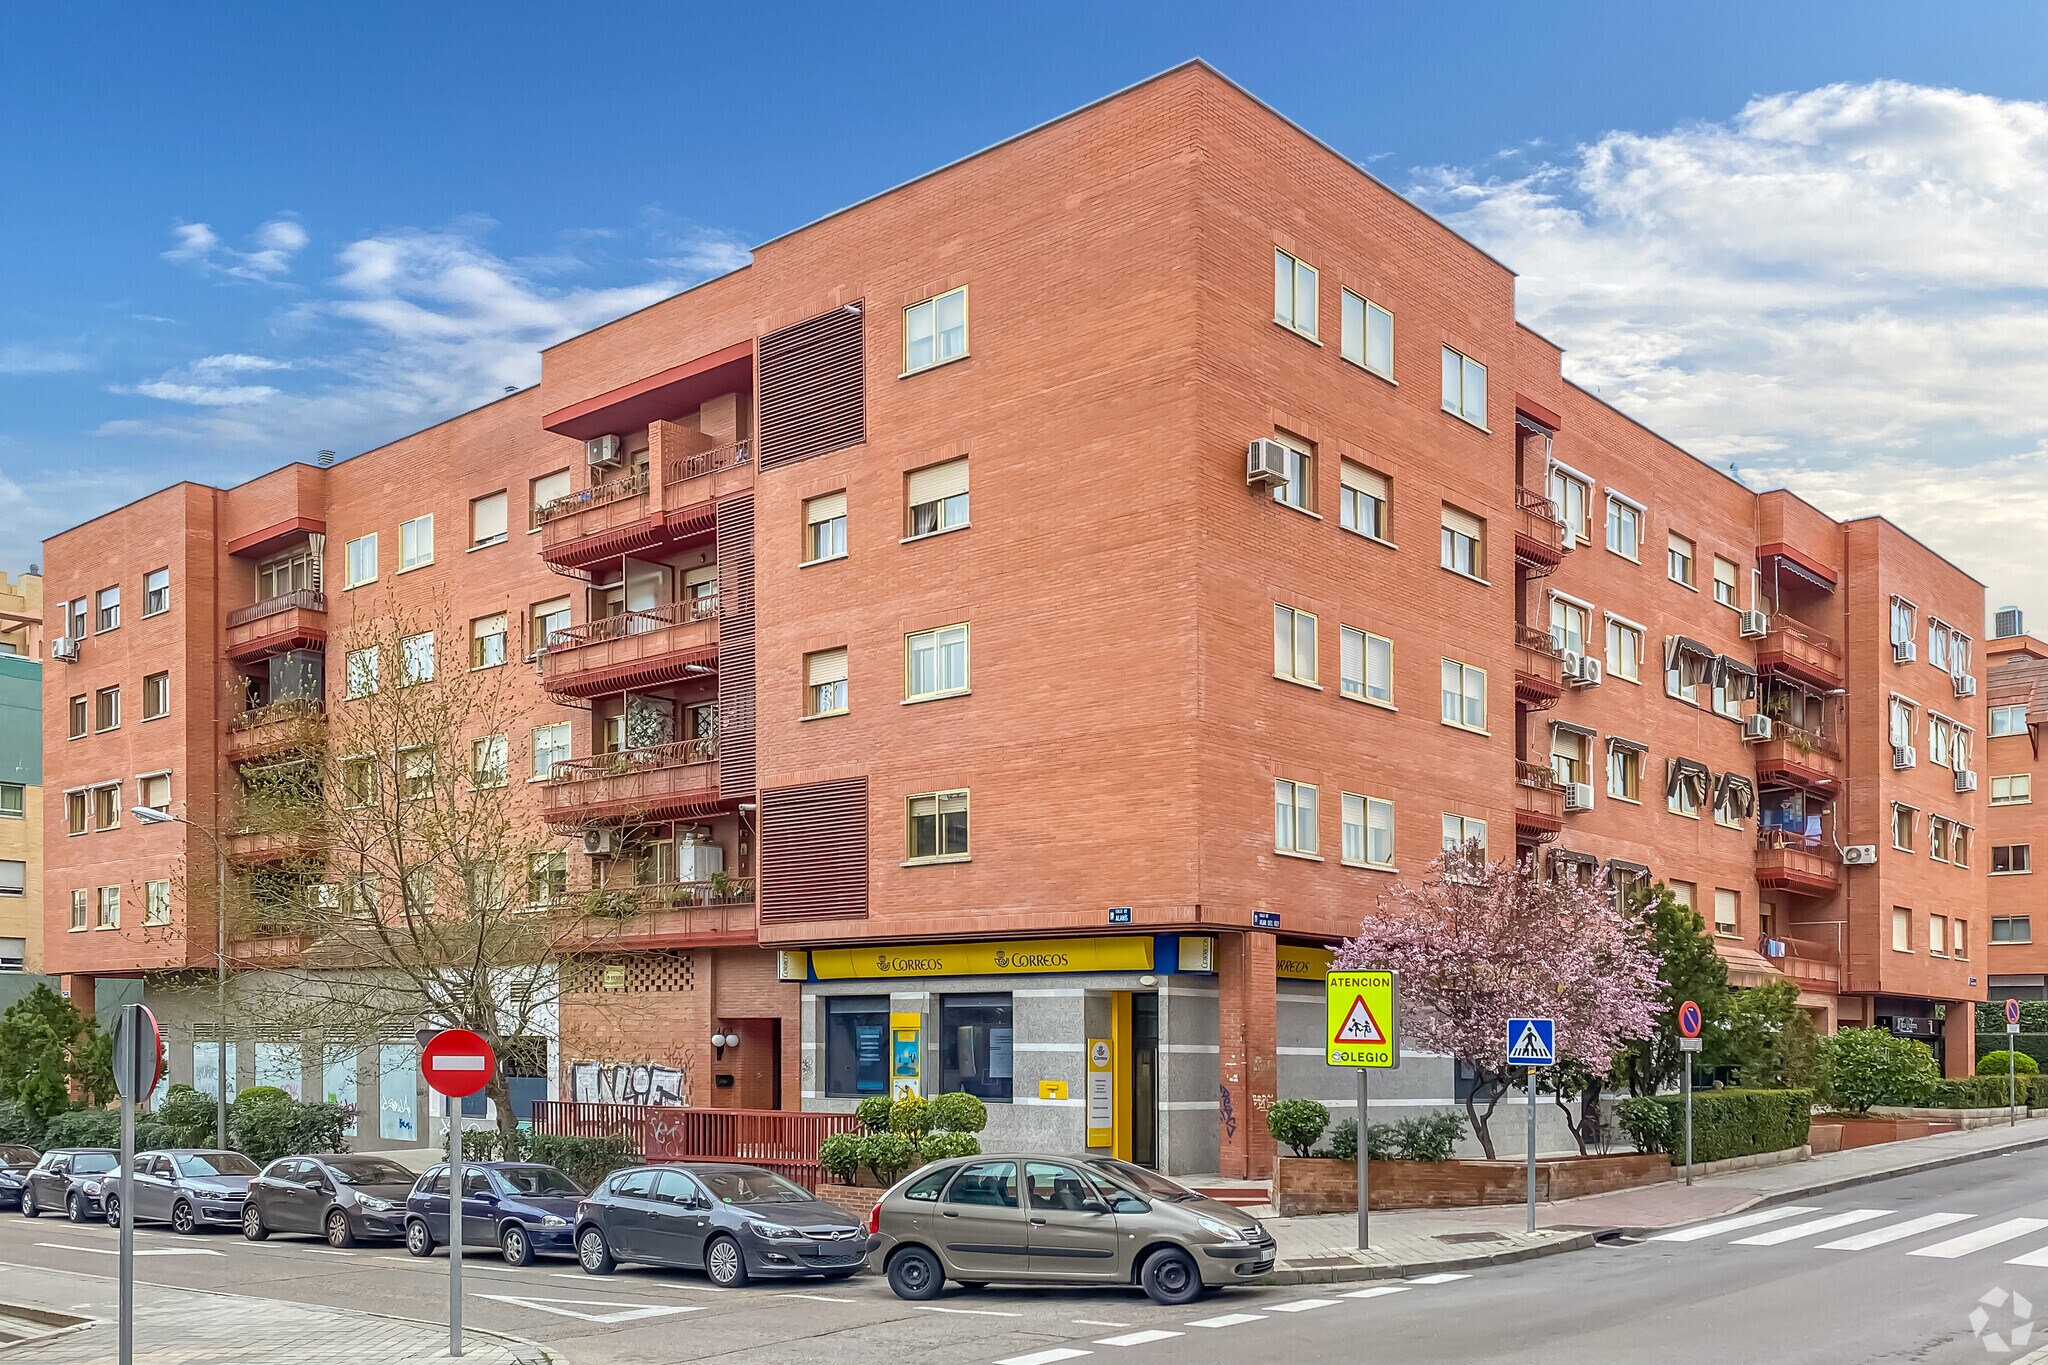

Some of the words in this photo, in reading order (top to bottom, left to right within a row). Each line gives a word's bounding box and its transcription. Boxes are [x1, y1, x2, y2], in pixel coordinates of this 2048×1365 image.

[892, 957, 943, 972] CORREOS
[1011, 953, 1068, 967] CORREOS
[1330, 978, 1390, 987] ATENCION
[1335, 1051, 1388, 1063] OLEGIO
